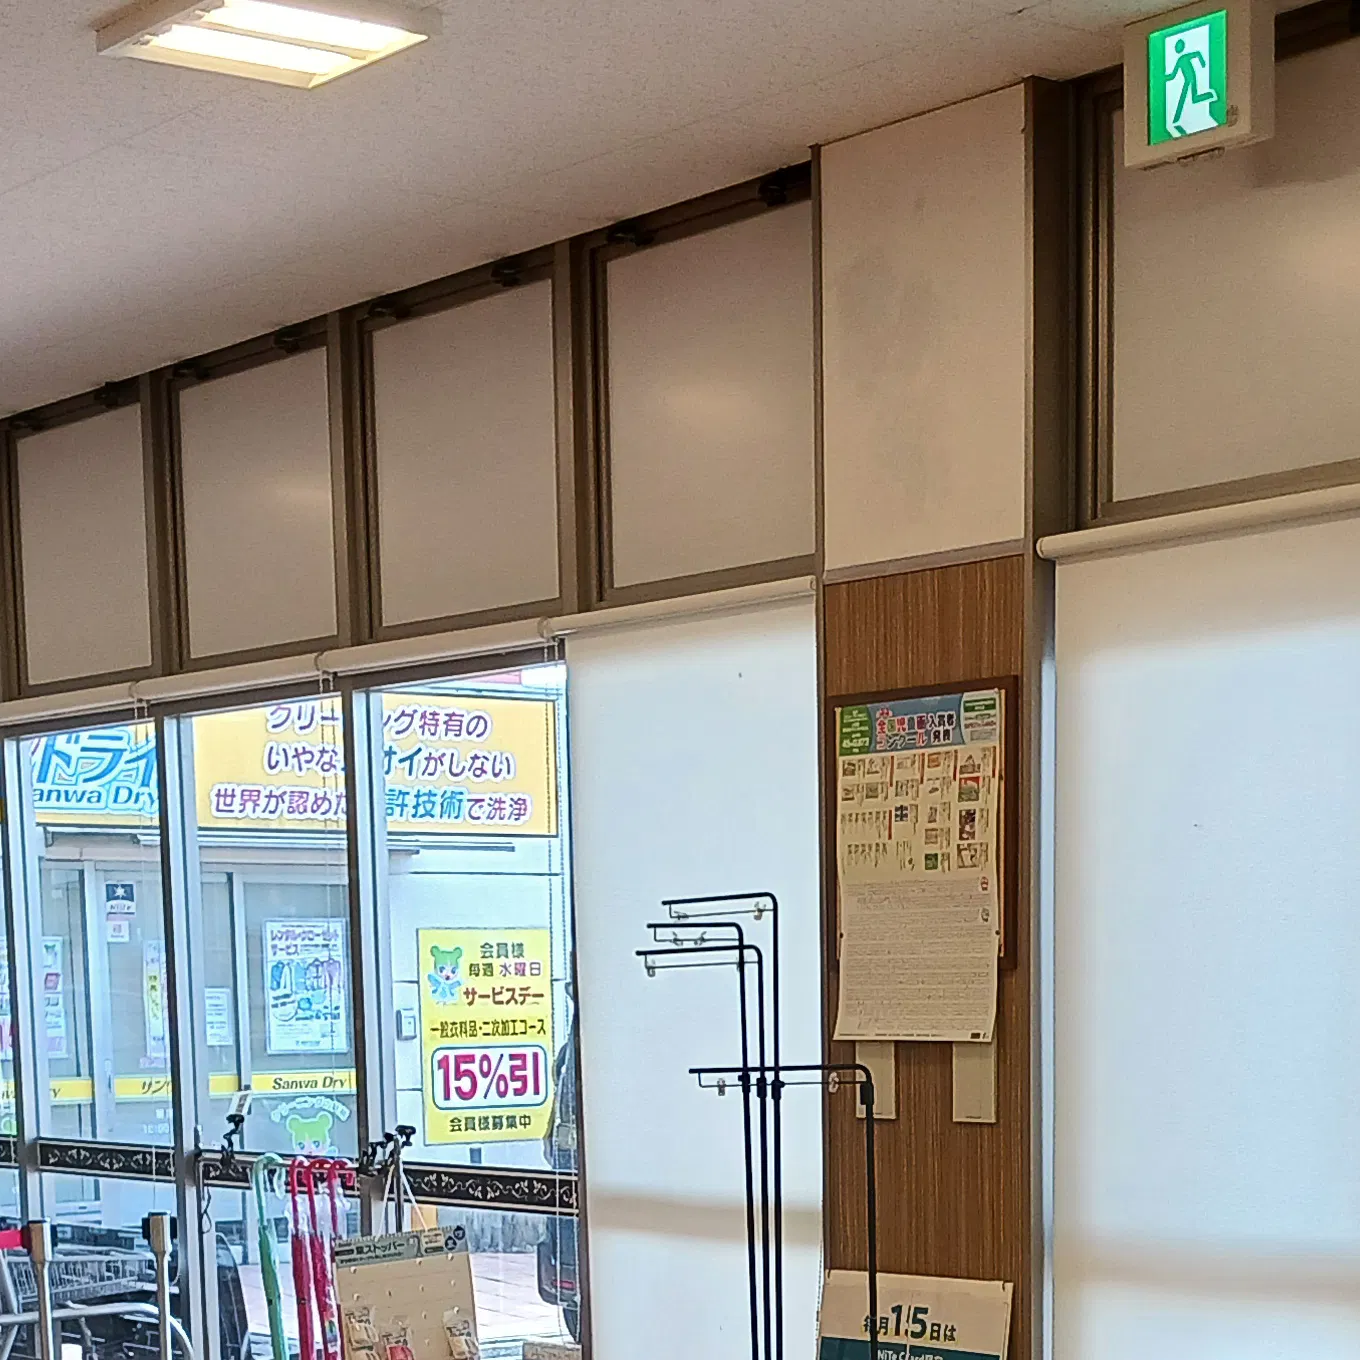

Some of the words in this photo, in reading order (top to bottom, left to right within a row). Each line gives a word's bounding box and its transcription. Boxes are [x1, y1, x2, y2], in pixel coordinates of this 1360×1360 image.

[33, 787, 102, 804] anwa
[479, 941, 525, 960] 会員様
[462, 986, 545, 1006] サービスデー
[271, 1077, 318, 1091] Sanwa
[322, 1075, 347, 1090] Dry
[437, 1051, 541, 1102] 15%引
